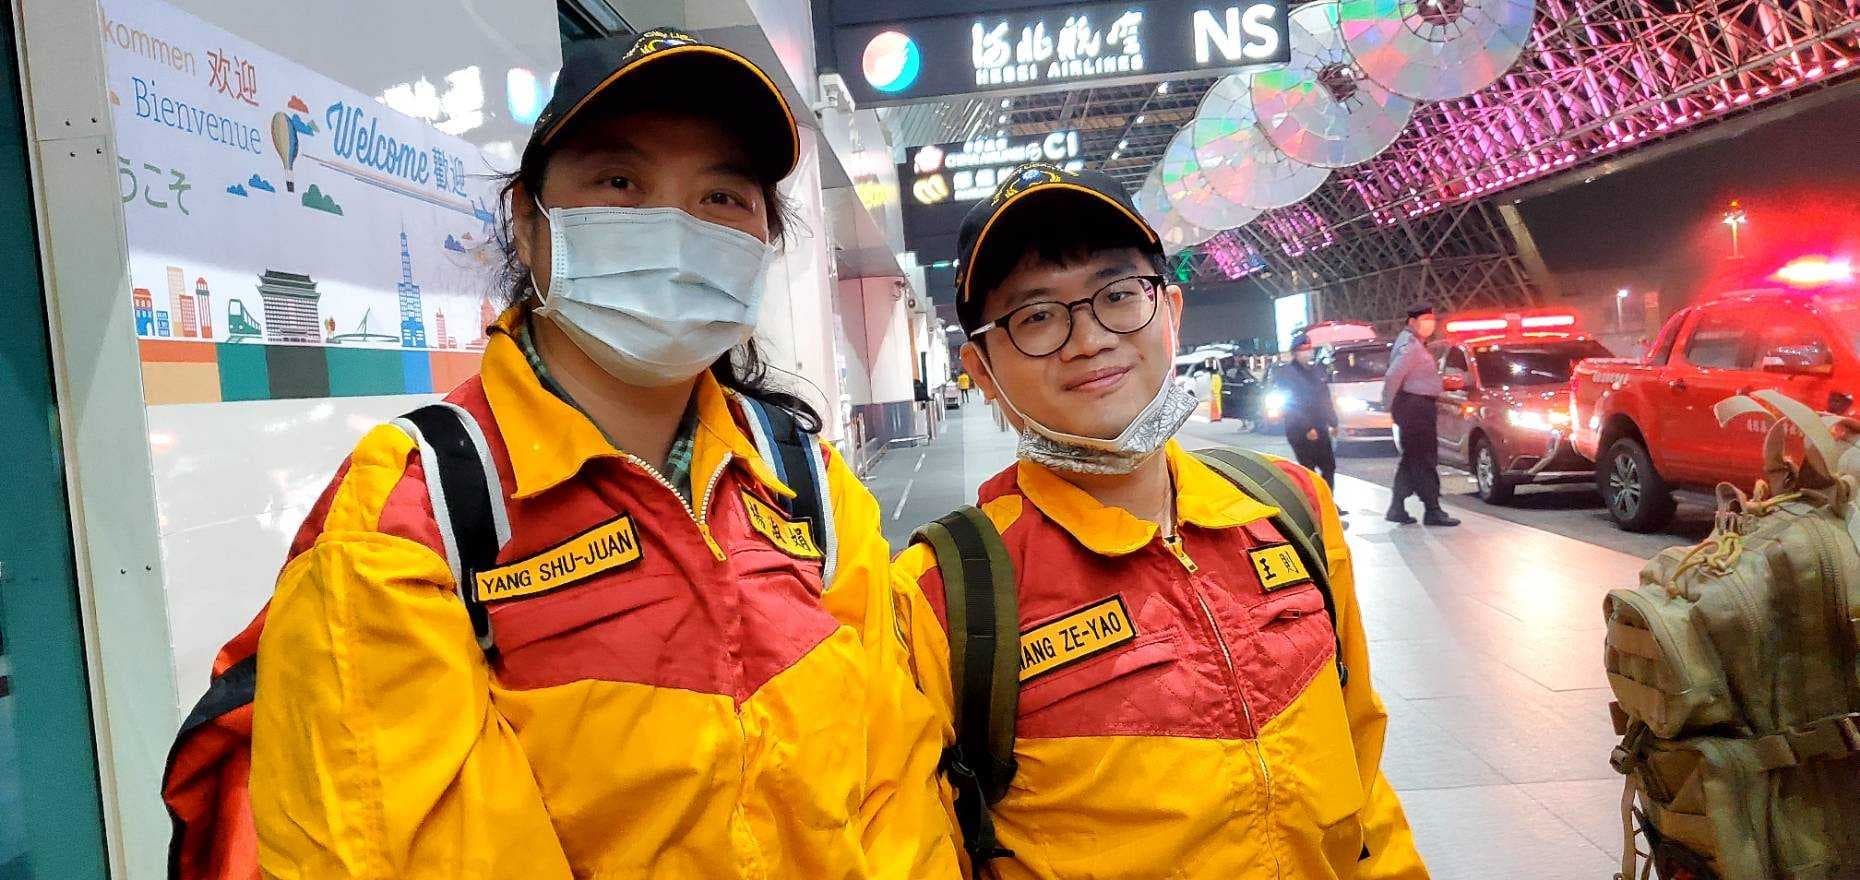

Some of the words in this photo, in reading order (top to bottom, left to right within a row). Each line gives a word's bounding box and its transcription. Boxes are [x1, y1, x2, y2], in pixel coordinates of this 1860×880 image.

[101, 9, 196, 76] kommen
[1193, 4, 1279, 63] NS
[207, 48, 259, 106] 欢迎
[132, 76, 262, 154] Bienvenue
[326, 101, 430, 184] Welcome
[432, 146, 467, 197] 歡迎
[1043, 131, 1079, 160] CI
[482, 569, 532, 594] YANG
[539, 530, 633, 582] SHU-JUAN
[1059, 611, 1122, 652] ZE-YAO
